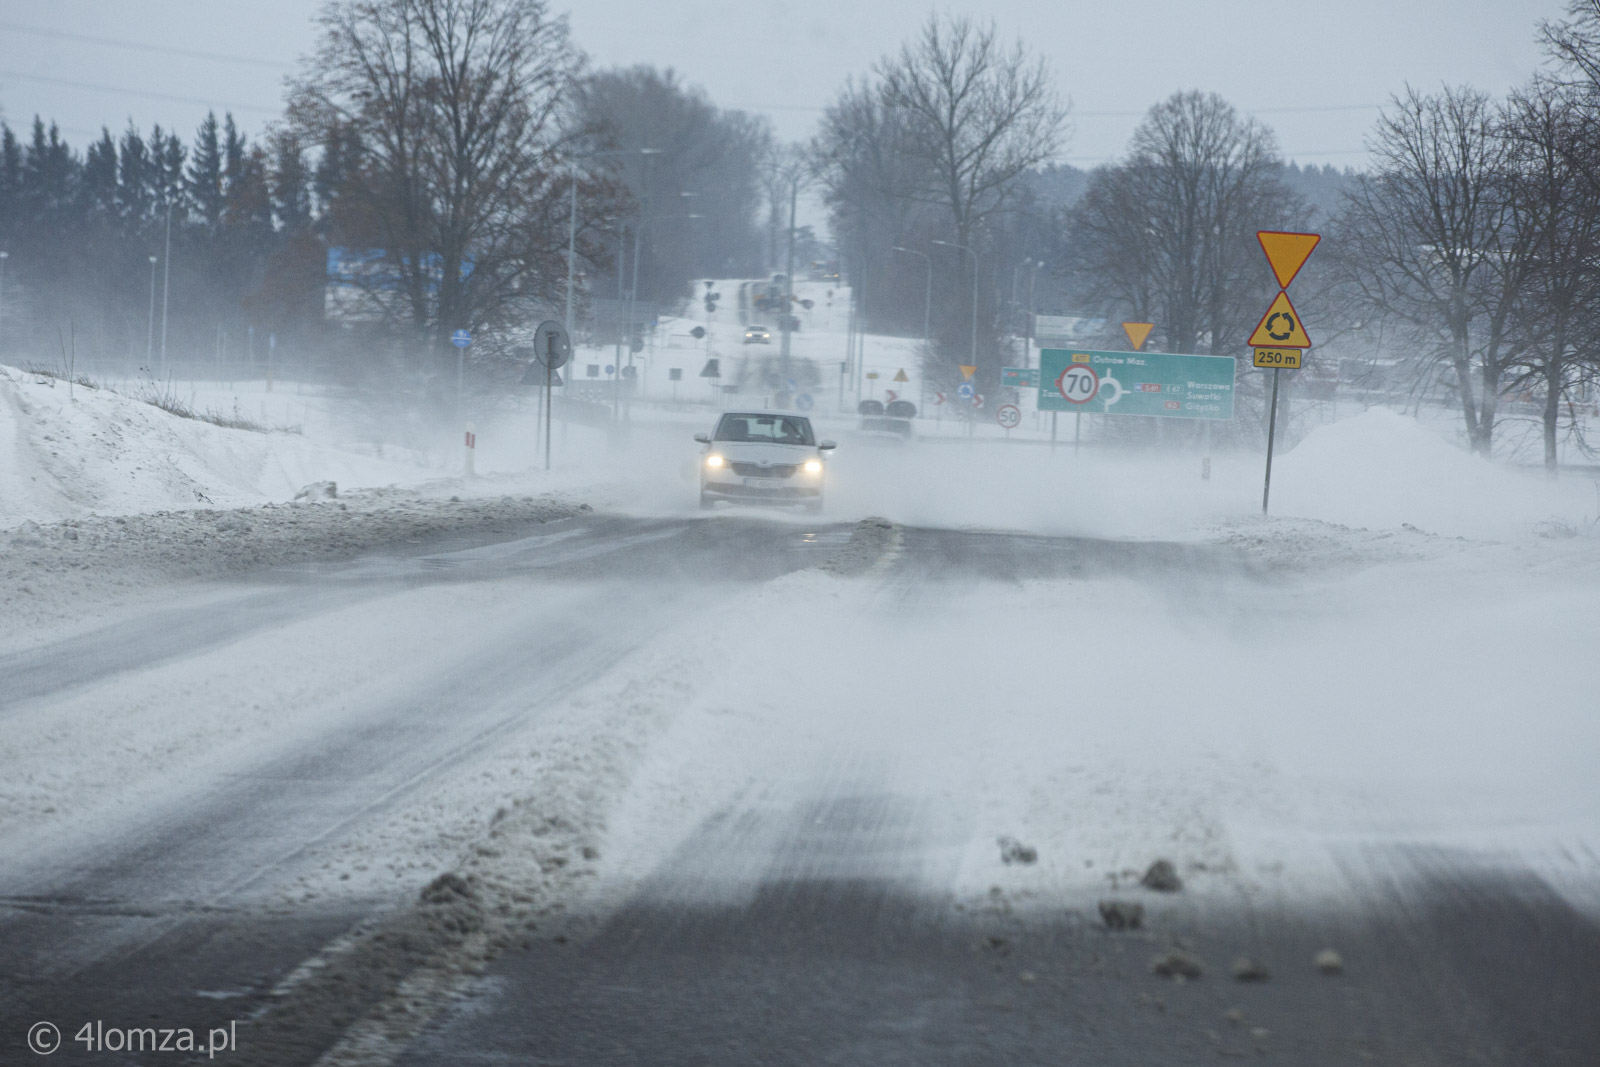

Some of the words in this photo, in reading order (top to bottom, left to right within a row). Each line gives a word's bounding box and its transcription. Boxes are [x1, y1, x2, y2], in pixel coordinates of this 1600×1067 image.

[1258, 352, 1282, 363] 250
[1285, 356, 1296, 364] m
[1067, 374, 1092, 394] 70
[1187, 381, 1231, 391] Warszawa
[1001, 411, 1017, 422] 50
